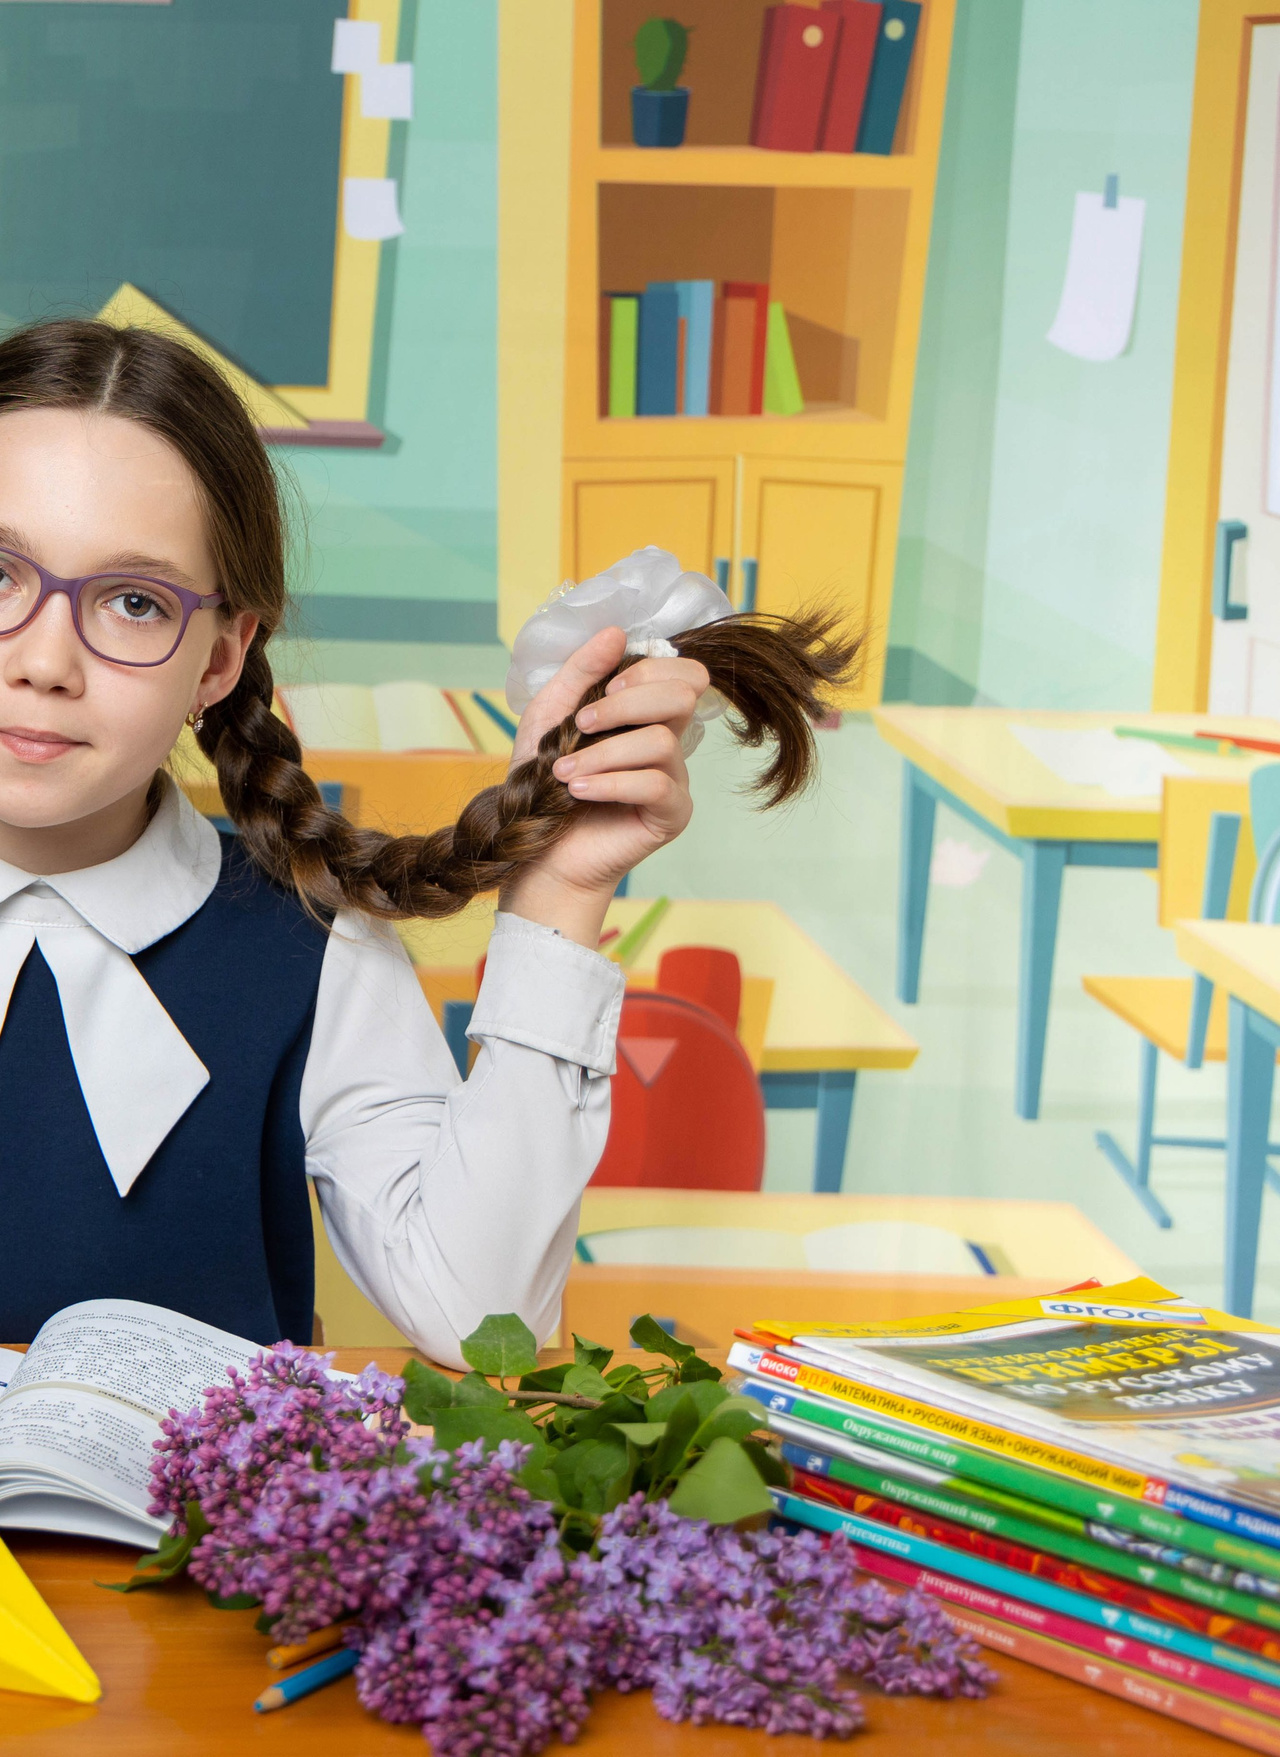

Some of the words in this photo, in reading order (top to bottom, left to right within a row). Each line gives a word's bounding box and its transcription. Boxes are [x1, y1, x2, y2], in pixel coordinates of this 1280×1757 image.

[1048, 1303, 1165, 1321] ФГОС
[926, 1329, 1198, 1368] ТРЕНИРОВОЧНЫЕ
[953, 1338, 1239, 1382] ПРИМЕРЫ
[1003, 1382, 1069, 1396] ПО
[1067, 1353, 1273, 1393] РУССКОМУ
[1114, 1379, 1255, 1409] ЯЗЫКУ
[760, 1357, 799, 1378] ФИОКО
[799, 1370, 829, 1388] ВПР
[830, 1381, 906, 1415] МАТЕМАТИКА
[912, 1407, 968, 1434] РУССКИЙ
[970, 1427, 1007, 1448] ЯЗЫК
[1014, 1440, 1110, 1480] ОКРУЖАЮЩИЙ
[1110, 1471, 1141, 1489] МИР
[1144, 1482, 1165, 1500] 24
[842, 1418, 930, 1455] Окружающий
[931, 1447, 959, 1467] мир
[880, 1479, 968, 1518] Окружающий
[970, 1511, 997, 1530] мир
[841, 1520, 911, 1555] Математика
[917, 1570, 1000, 1608] Литературное
[1002, 1600, 1046, 1624] чтение
